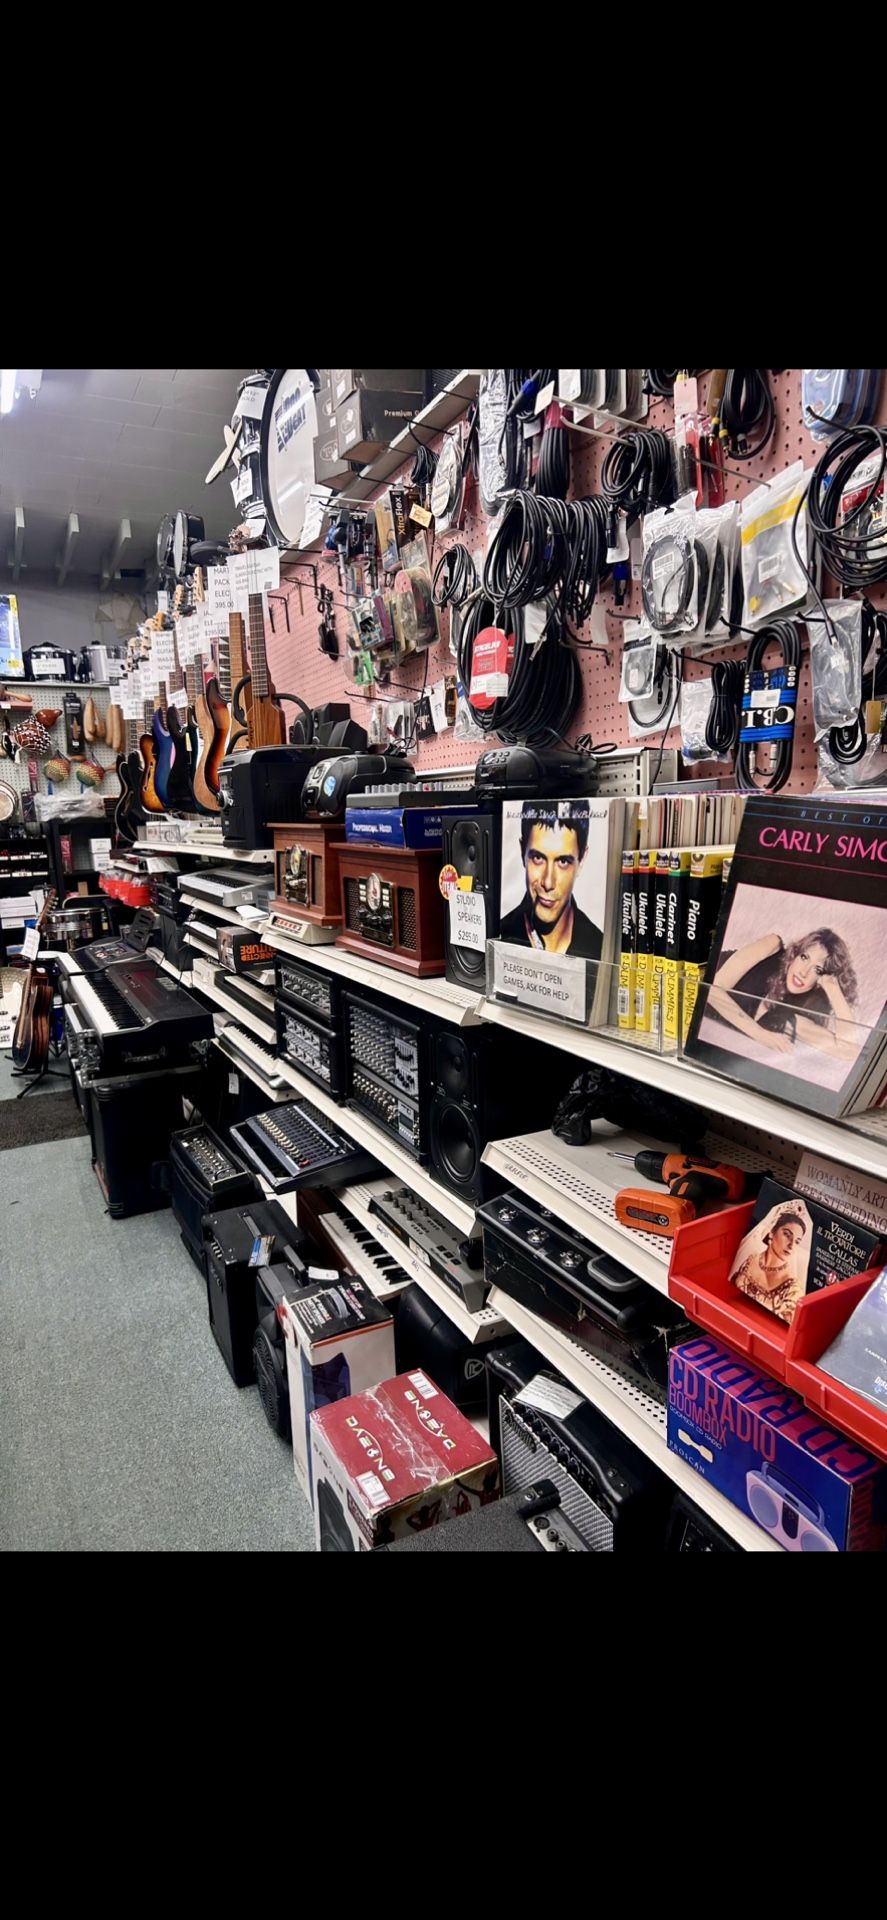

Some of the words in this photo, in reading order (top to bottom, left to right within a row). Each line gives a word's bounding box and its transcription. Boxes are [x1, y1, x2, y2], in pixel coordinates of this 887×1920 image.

[384, 409, 413, 418] Premium
[800, 809, 848, 821] BEST
[758, 826, 830, 854] CARLY
[457, 911, 482, 926] SPEAKERS
[622, 892, 632, 935] Ukulele
[638, 892, 648, 936] Ukulele
[655, 893, 667, 938] Ukulele
[667, 892, 677, 945] Clarinet
[687, 899, 700, 941] Piano
[503, 962, 523, 975] PLEASE
[524, 967, 543, 979] DON'T
[544, 973, 562, 985] OPEN
[503, 975, 526, 990] GAMES,
[526, 982, 538, 993] ASK
[539, 985, 551, 996] FOR
[553, 990, 569, 1001] HELP
[667, 969, 676, 1022] DUMMIES
[806, 1164, 864, 1199] WOMANLY
[862, 1189, 887, 1210] ART
[823, 1229, 867, 1260] TROVATORE
[828, 1243, 860, 1268] CALLAS
[669, 1354, 699, 1401] CD
[704, 1378, 777, 1462] RADIO
[669, 1383, 728, 1448] BOOMBOX
[676, 1339, 808, 1429] RADIO
[797, 1425, 877, 1480] CD
[669, 1439, 706, 1475] PROSCAN
[695, 1426, 704, 1435] CD
[704, 1432, 723, 1451] RADIO
